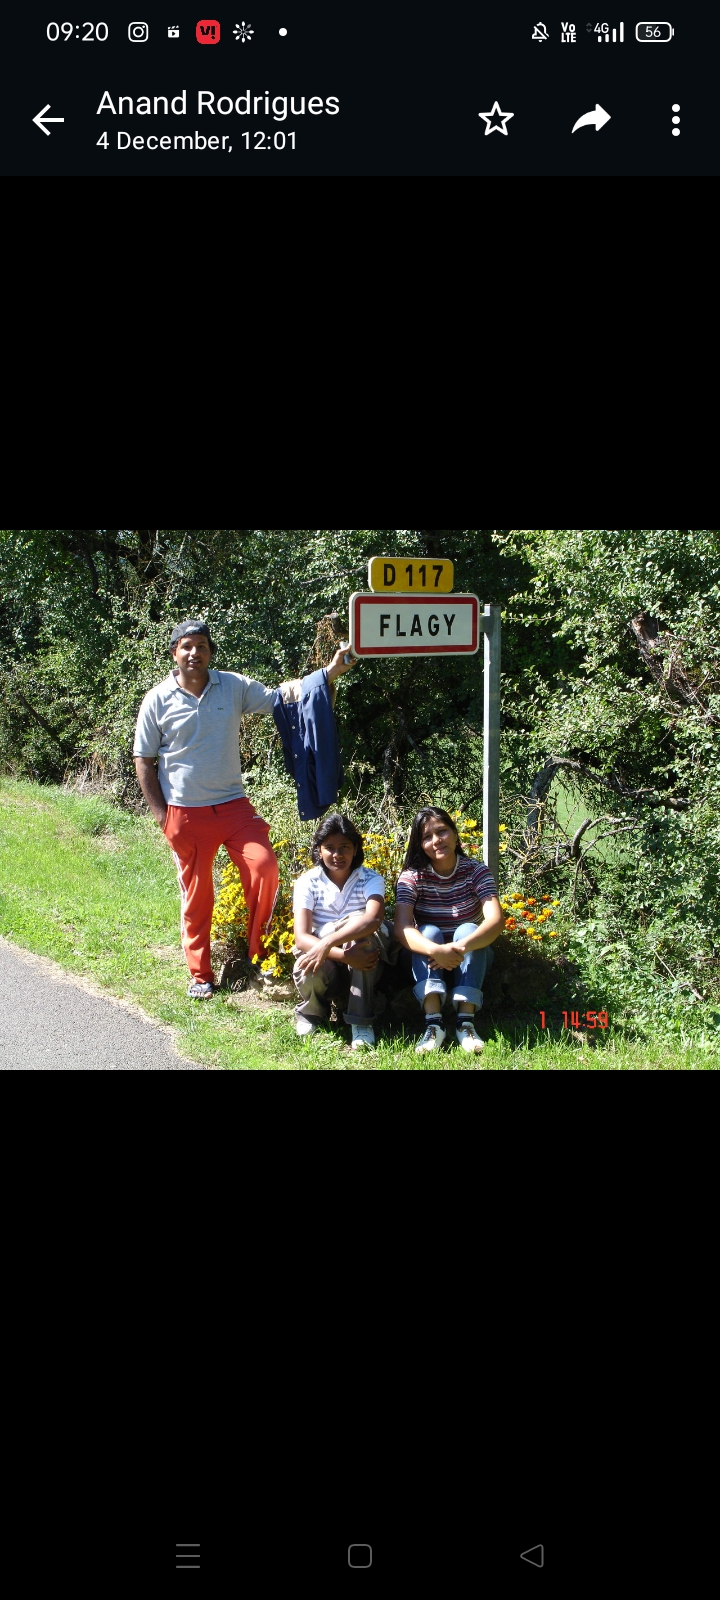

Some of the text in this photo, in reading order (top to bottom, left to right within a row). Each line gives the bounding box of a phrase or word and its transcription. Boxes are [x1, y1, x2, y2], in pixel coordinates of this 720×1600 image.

[46, 21, 109, 42] 09:20
[560, 21, 576, 32] Vo
[560, 31, 577, 43] LTE
[593, 22, 610, 34] 4G
[645, 25, 662, 38] 56
[95, 89, 340, 122] Anand Rodrigues
[95, 130, 297, 154] 4 December, 12:01
[383, 563, 444, 587] D 117
[379, 614, 456, 637] FLAGY
